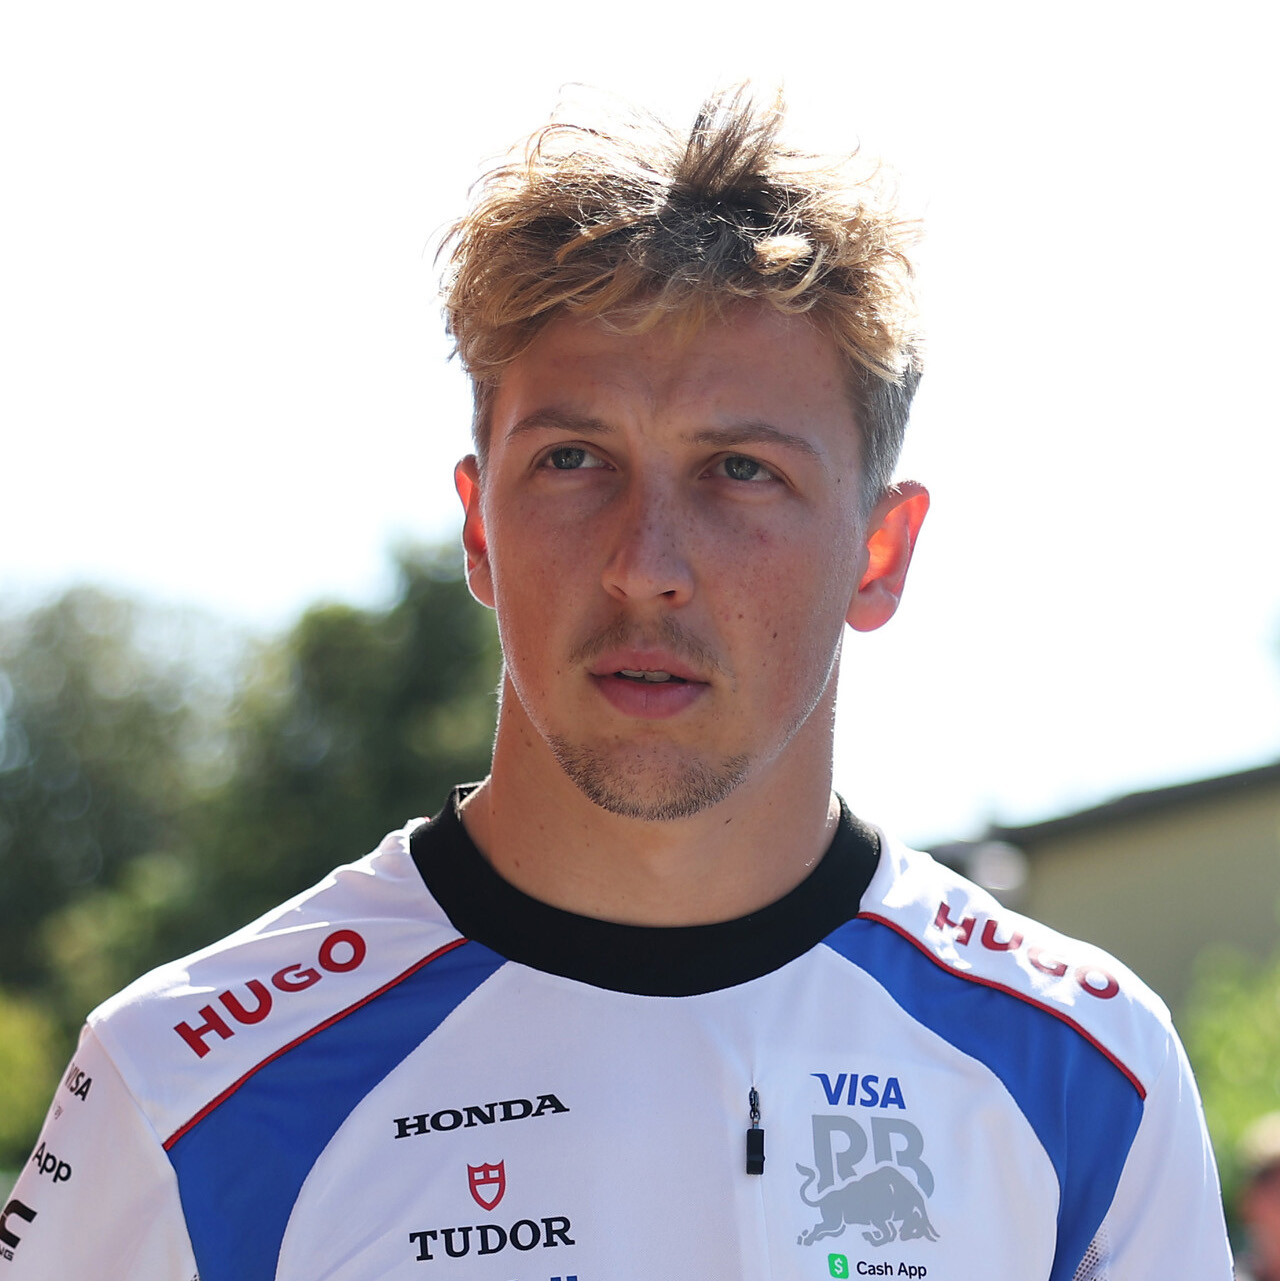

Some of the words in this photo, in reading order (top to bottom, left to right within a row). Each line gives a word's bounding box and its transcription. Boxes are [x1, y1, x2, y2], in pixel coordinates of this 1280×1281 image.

[933, 901, 1120, 1000] HUGO
[173, 929, 367, 1058] HUGO
[810, 1073, 907, 1110] VISA
[393, 1093, 570, 1140] HONDA
[31, 1141, 72, 1183] App
[409, 1216, 575, 1262] TUDOR
[856, 1261, 894, 1276] Cash
[897, 1262, 928, 1280] App
